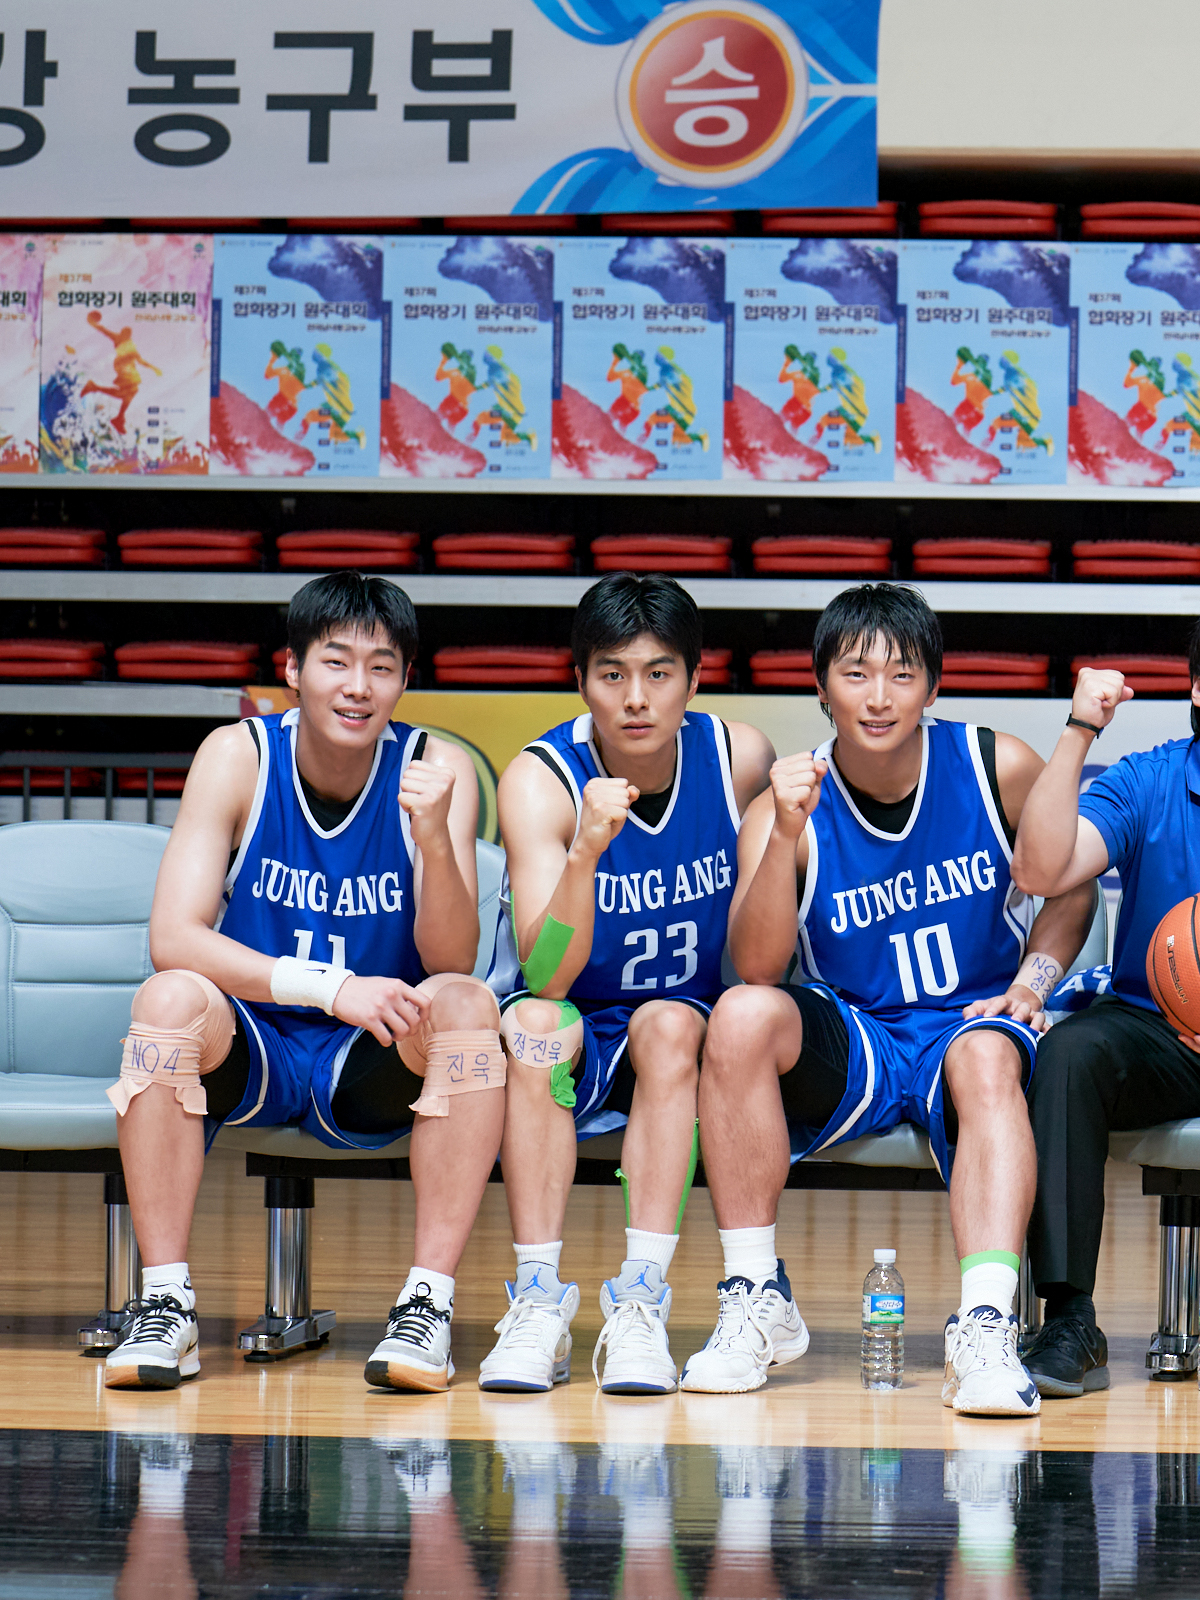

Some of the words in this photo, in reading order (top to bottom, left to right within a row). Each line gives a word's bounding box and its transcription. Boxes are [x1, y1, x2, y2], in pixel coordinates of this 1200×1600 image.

[127, 27, 517, 168] 농구부
[664, 35, 760, 148] 승
[130, 290, 197, 309] 원주대회
[303, 301, 368, 318] 원주대회
[474, 303, 539, 320] 원주대회
[643, 303, 710, 320] 원주대회
[815, 304, 882, 322] 원주대회
[987, 306, 1054, 324] 원주대회
[252, 857, 329, 913] JUNG
[332, 871, 404, 917] ANG
[594, 868, 667, 914] UNG
[672, 848, 732, 905] ANG
[830, 869, 918, 934] JUNG
[924, 849, 997, 906] ANG
[293, 929, 347, 970] 11
[620, 920, 699, 991] 23
[889, 922, 960, 1004] 10
[131, 1039, 160, 1073] NO
[163, 1048, 181, 1076] 4
[513, 1032, 562, 1065] 정진욱
[446, 1052, 490, 1084] 진욱
